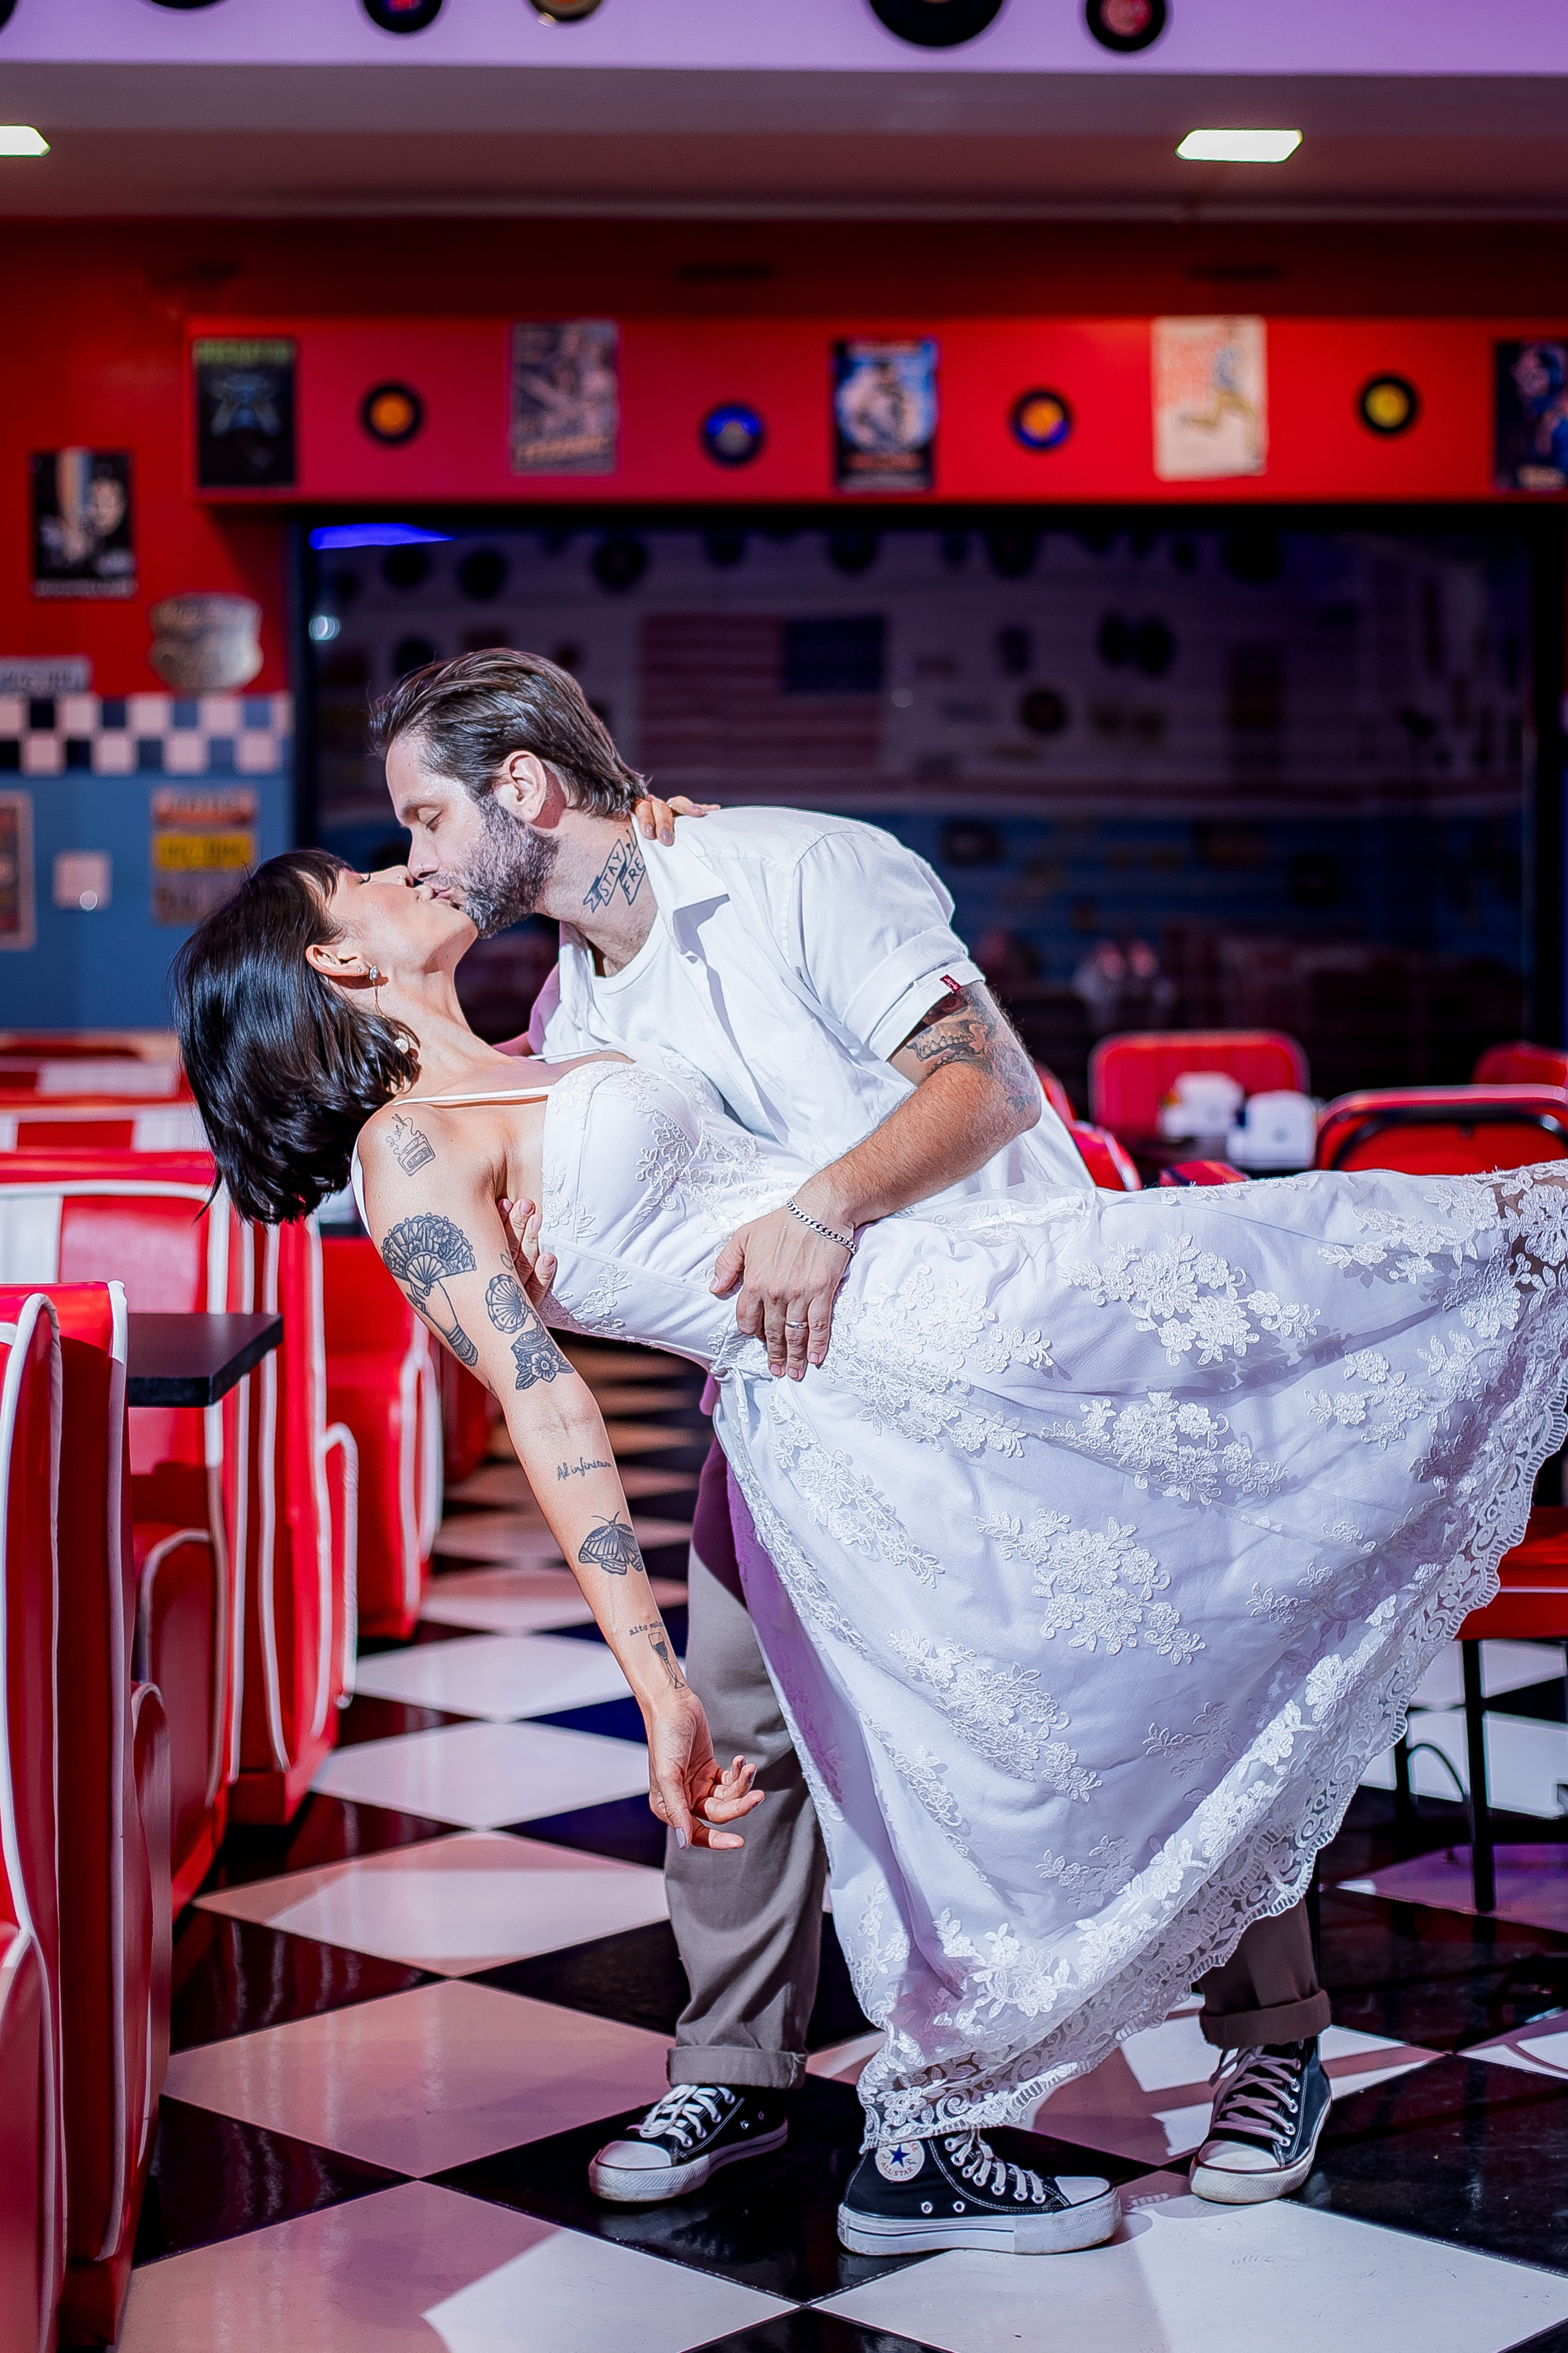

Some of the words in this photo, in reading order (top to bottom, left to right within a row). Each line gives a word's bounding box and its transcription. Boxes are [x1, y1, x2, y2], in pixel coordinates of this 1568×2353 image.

[599, 851, 622, 897] STAY
[622, 856, 644, 895] FRE
[629, 1625, 647, 1636] alto
[881, 2162, 892, 2174] ALL
[894, 2167, 913, 2177] STAR
